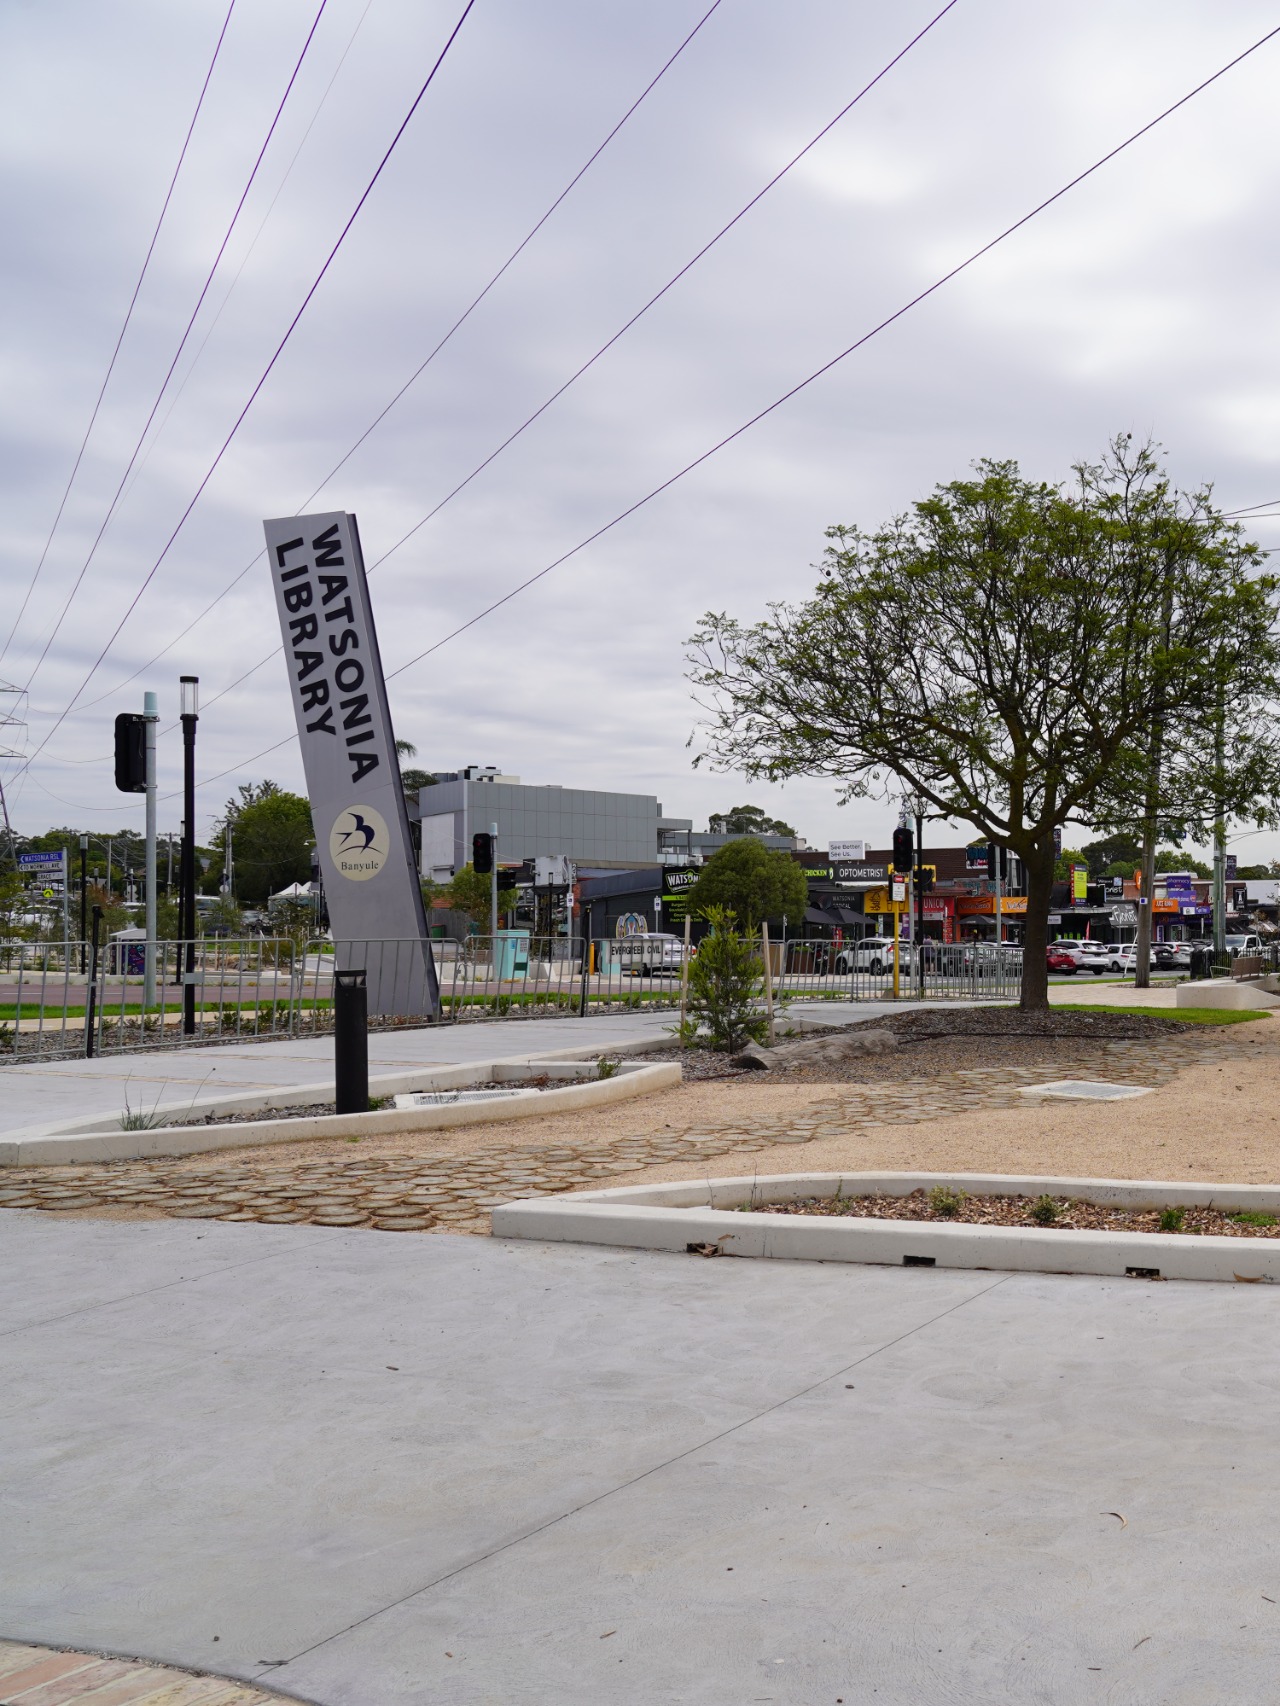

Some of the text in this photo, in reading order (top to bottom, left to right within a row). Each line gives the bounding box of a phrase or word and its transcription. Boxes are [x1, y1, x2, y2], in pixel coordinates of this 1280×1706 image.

[276, 537, 337, 736] LIBRARY
[312, 523, 380, 784] WATSONIA
[341, 861, 379, 872] Banyule
[839, 868, 884, 878] OPTOMETRIST
[667, 874, 702, 887] WATSON
